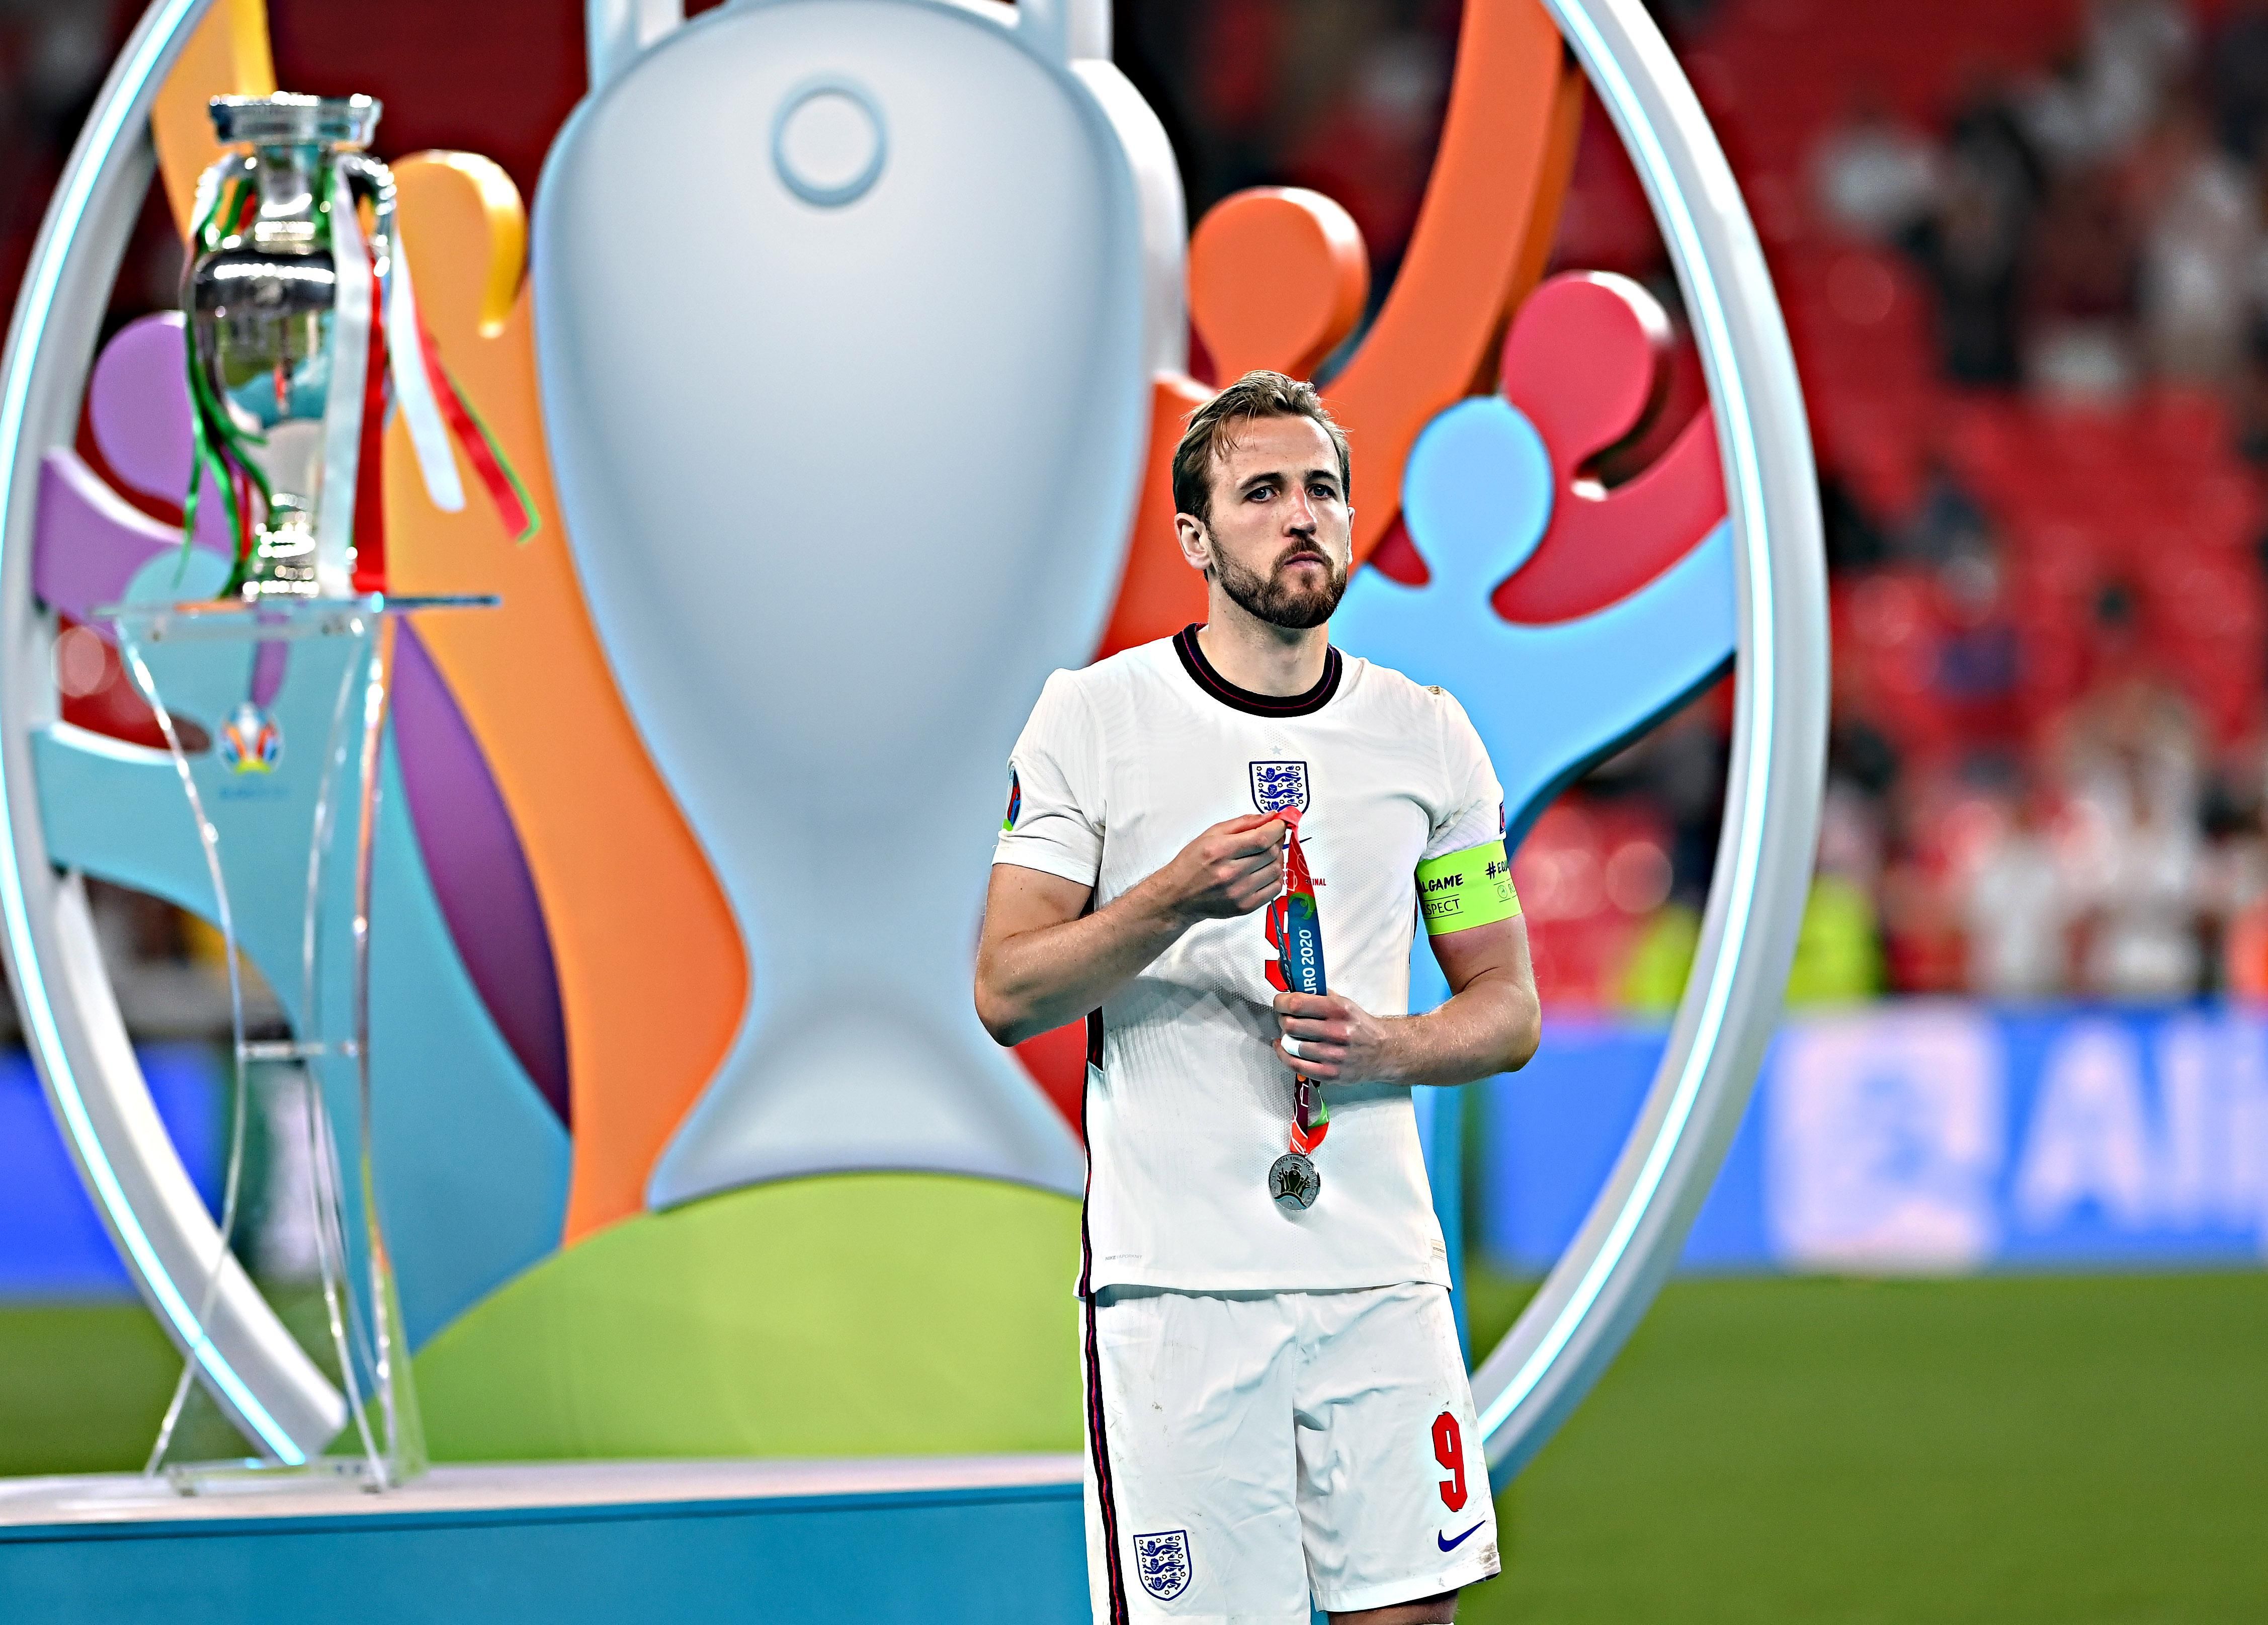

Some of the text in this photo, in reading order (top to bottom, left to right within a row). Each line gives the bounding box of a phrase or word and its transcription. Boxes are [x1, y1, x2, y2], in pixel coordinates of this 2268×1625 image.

[1311, 878, 1326, 886] INAL
[1299, 929, 1317, 995] URO 2020
[1303, 1162, 1314, 1174] 2020
[1432, 1411, 1468, 1512] 9
